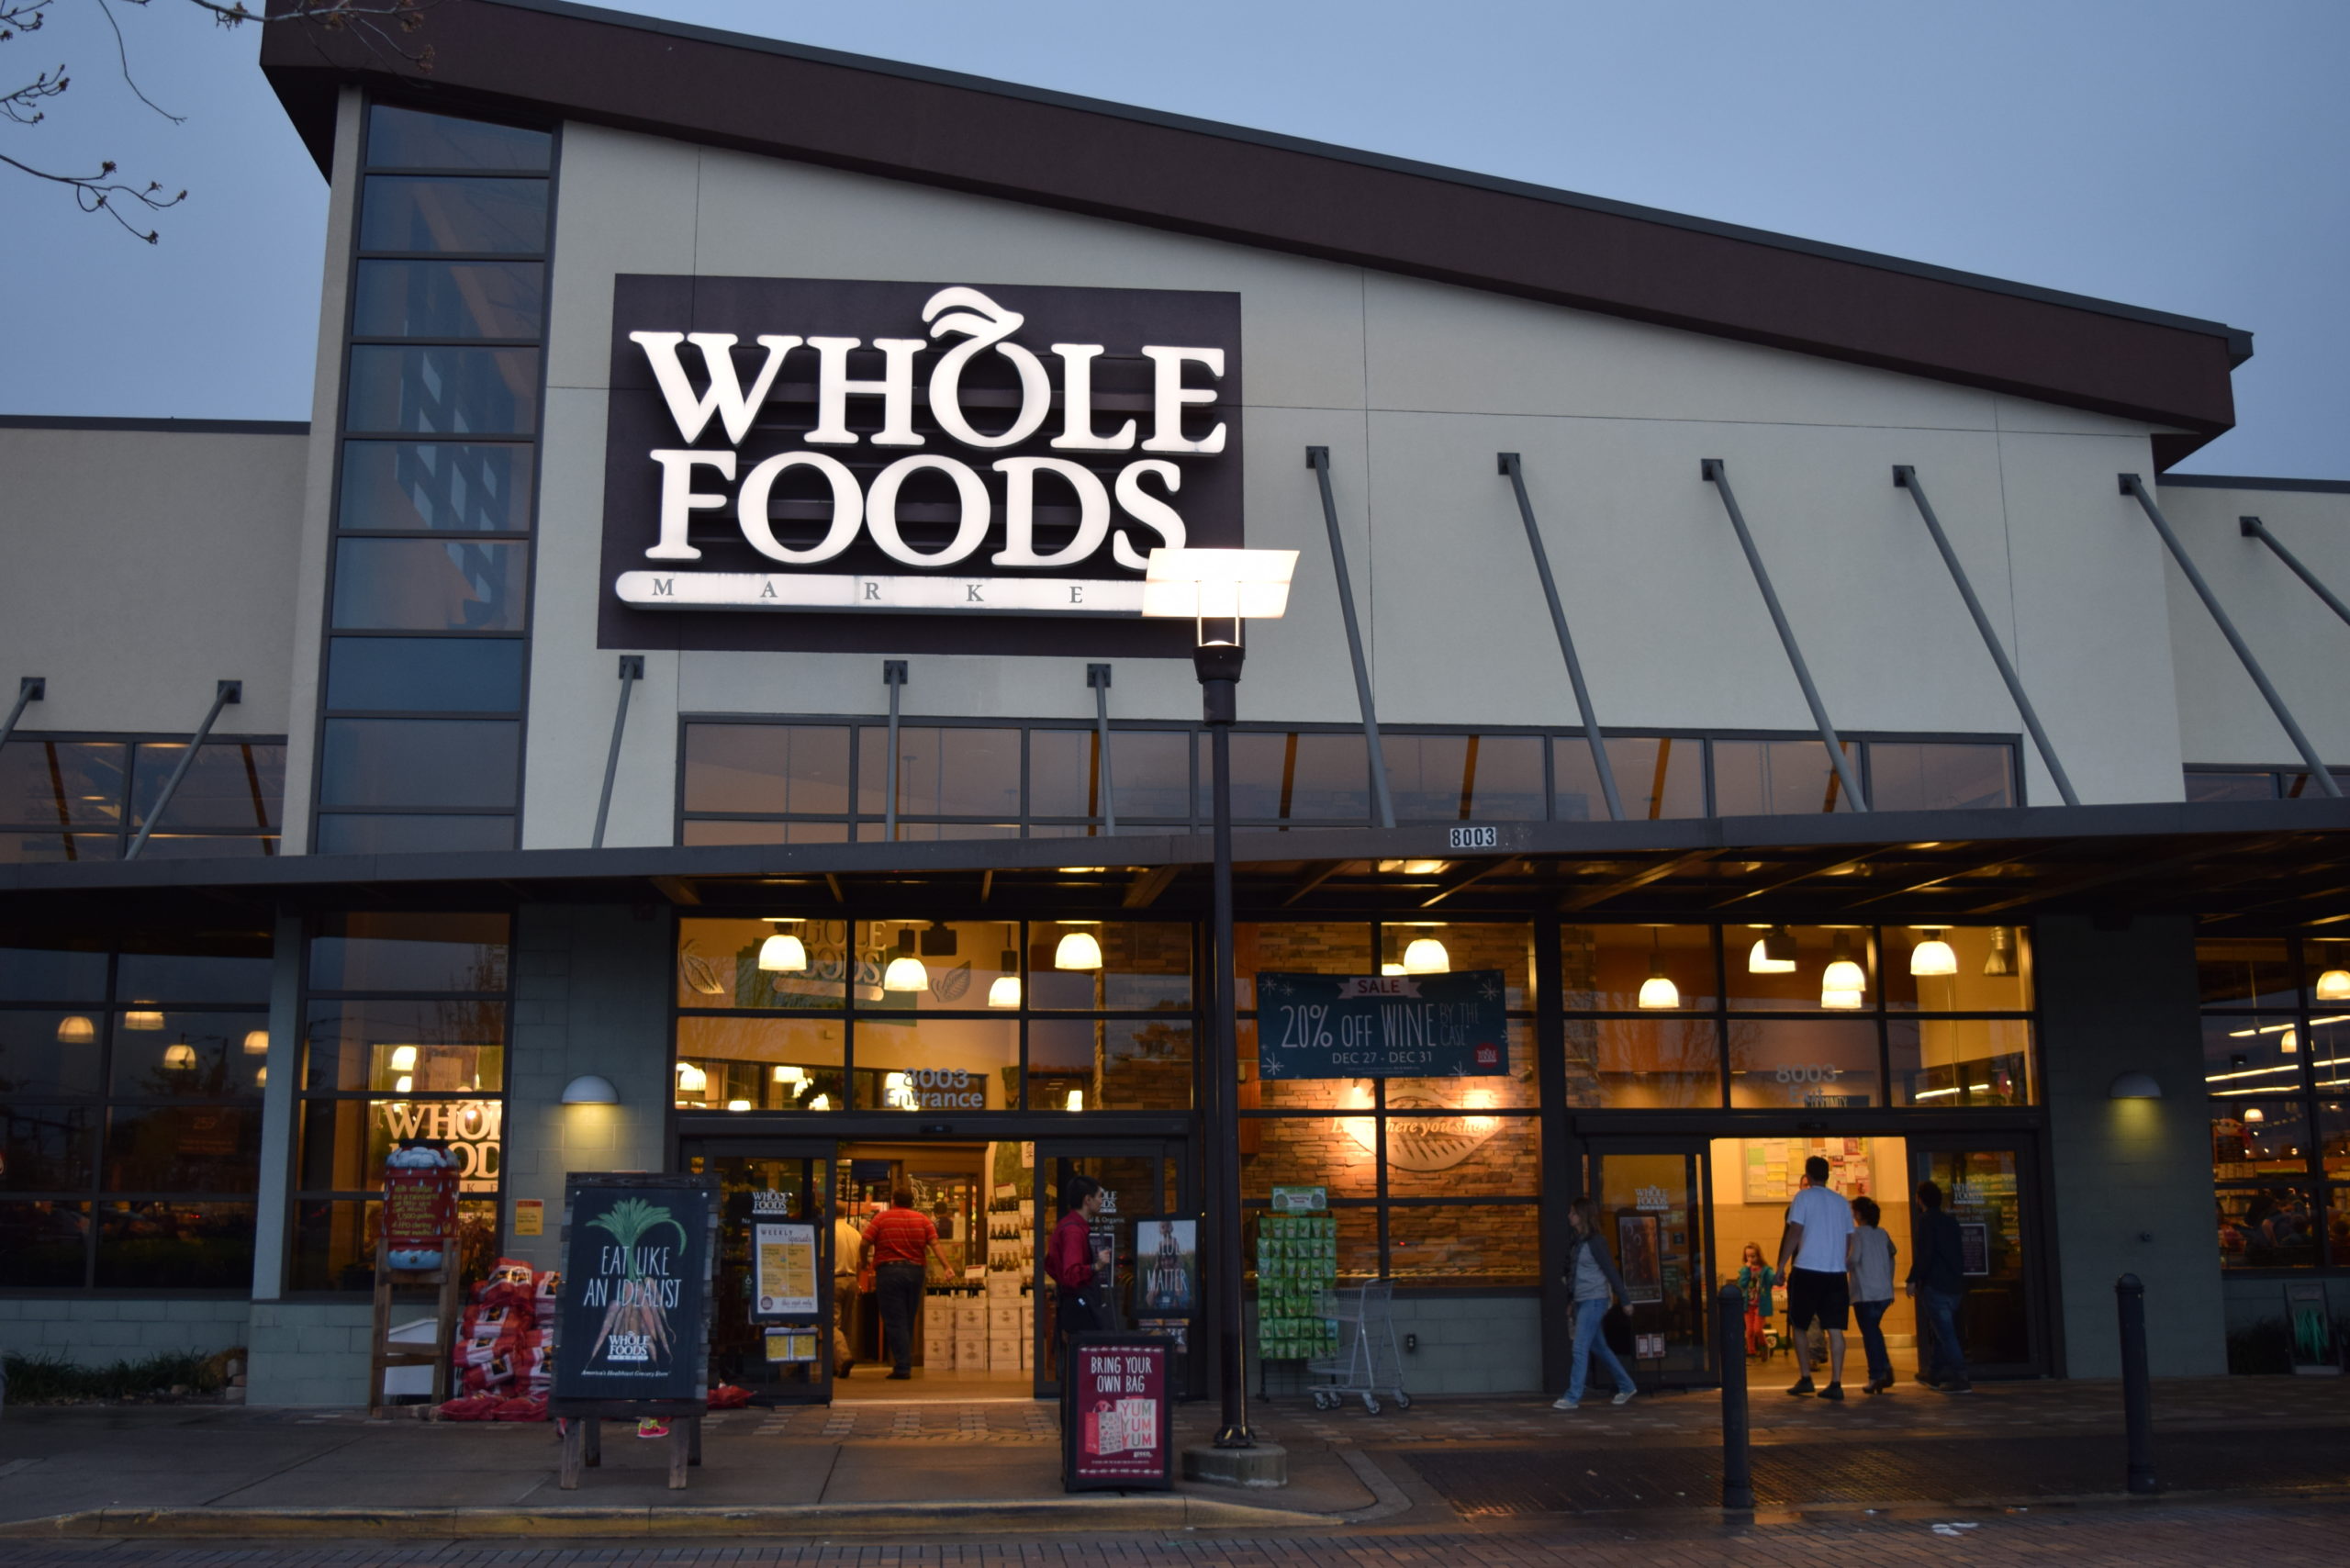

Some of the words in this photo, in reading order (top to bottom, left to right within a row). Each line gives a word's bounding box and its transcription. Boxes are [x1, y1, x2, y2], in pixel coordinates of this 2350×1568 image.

[630, 287, 1226, 454] WHOLE
[645, 449, 1187, 571] FOODS
[651, 577, 1084, 606] MARKE
[1451, 827, 1494, 846] 8003
[1358, 979, 1401, 994] SALE
[1280, 1003, 1334, 1048] 20%
[1341, 1014, 1373, 1047] OFF
[1380, 1002, 1437, 1047] WINE
[1438, 1002, 1455, 1025] BY
[1459, 1002, 1481, 1025] THE
[1332, 1051, 1360, 1065] DEC
[1362, 1051, 1378, 1064] 27
[1388, 1050, 1416, 1063] DEC
[1419, 1049, 1433, 1062] 31
[902, 1067, 969, 1089] 8003
[1775, 1064, 1837, 1083] 8003
[883, 1087, 984, 1108] Entrance
[1422, 1119, 1452, 1137] you
[601, 1245, 630, 1276] EAT
[636, 1246, 670, 1276] LIKE
[1147, 1269, 1188, 1292] MATTER
[583, 1278, 609, 1307] AN
[616, 1278, 682, 1308] IDEALIST
[609, 1330, 651, 1346] WHOLE
[610, 1345, 647, 1355] FOODS
[1091, 1356, 1121, 1374] BRING
[1125, 1356, 1153, 1374] YOUR
[1096, 1374, 1121, 1393] OWN
[1125, 1374, 1146, 1393] BAG
[1121, 1402, 1151, 1417] YUM
[1122, 1417, 1151, 1432] YUM
[1123, 1433, 1152, 1448] YUM
